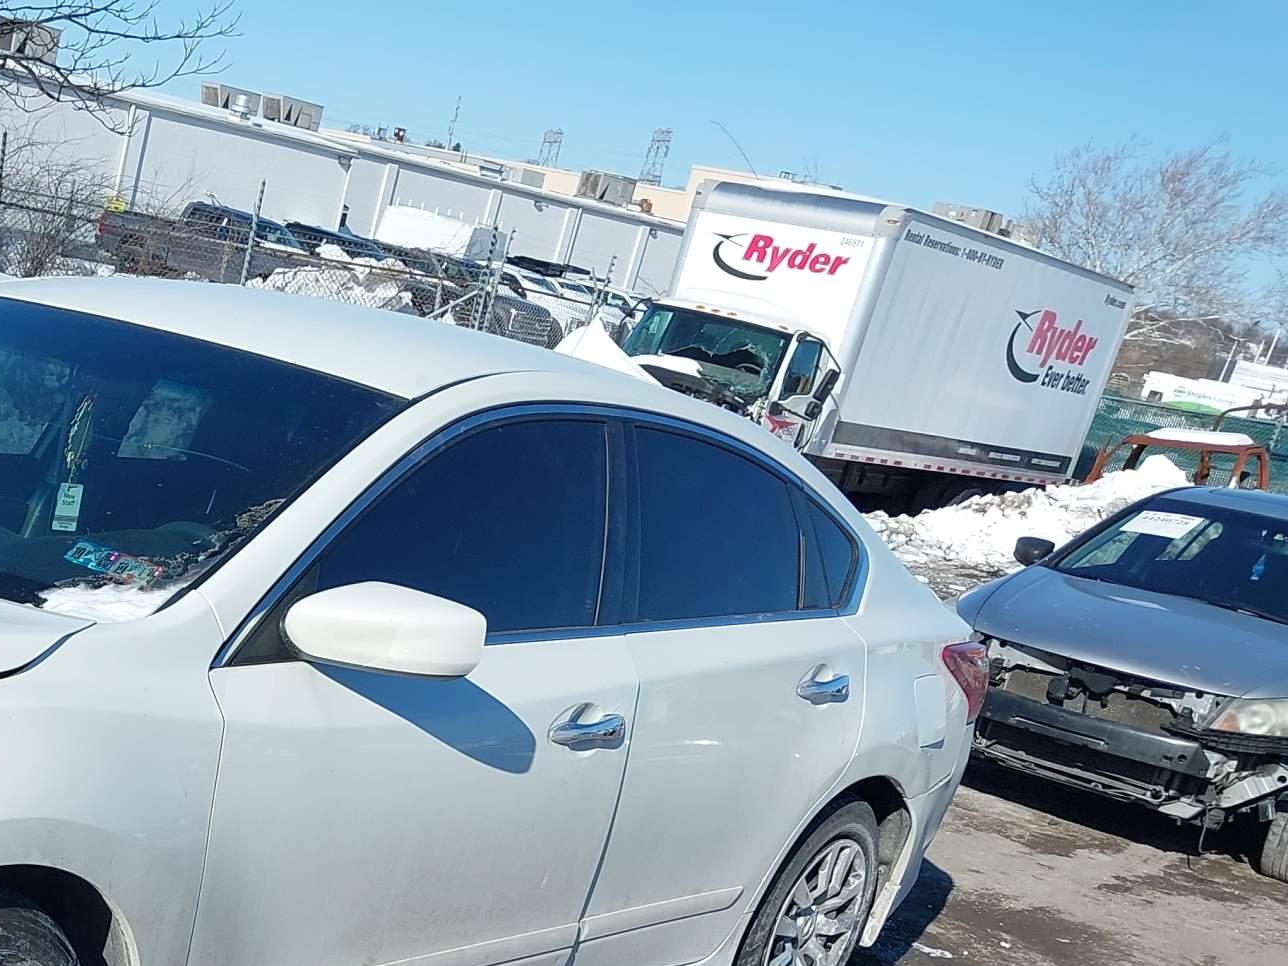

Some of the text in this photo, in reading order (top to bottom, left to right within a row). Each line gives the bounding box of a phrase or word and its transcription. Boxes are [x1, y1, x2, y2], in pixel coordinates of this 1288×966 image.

[742, 233, 850, 276] Ryder
[904, 228, 925, 246] Rental
[923, 235, 961, 257] Reservations:
[1026, 309, 1099, 369] Ryder
[1040, 365, 1090, 396] Ever better.
